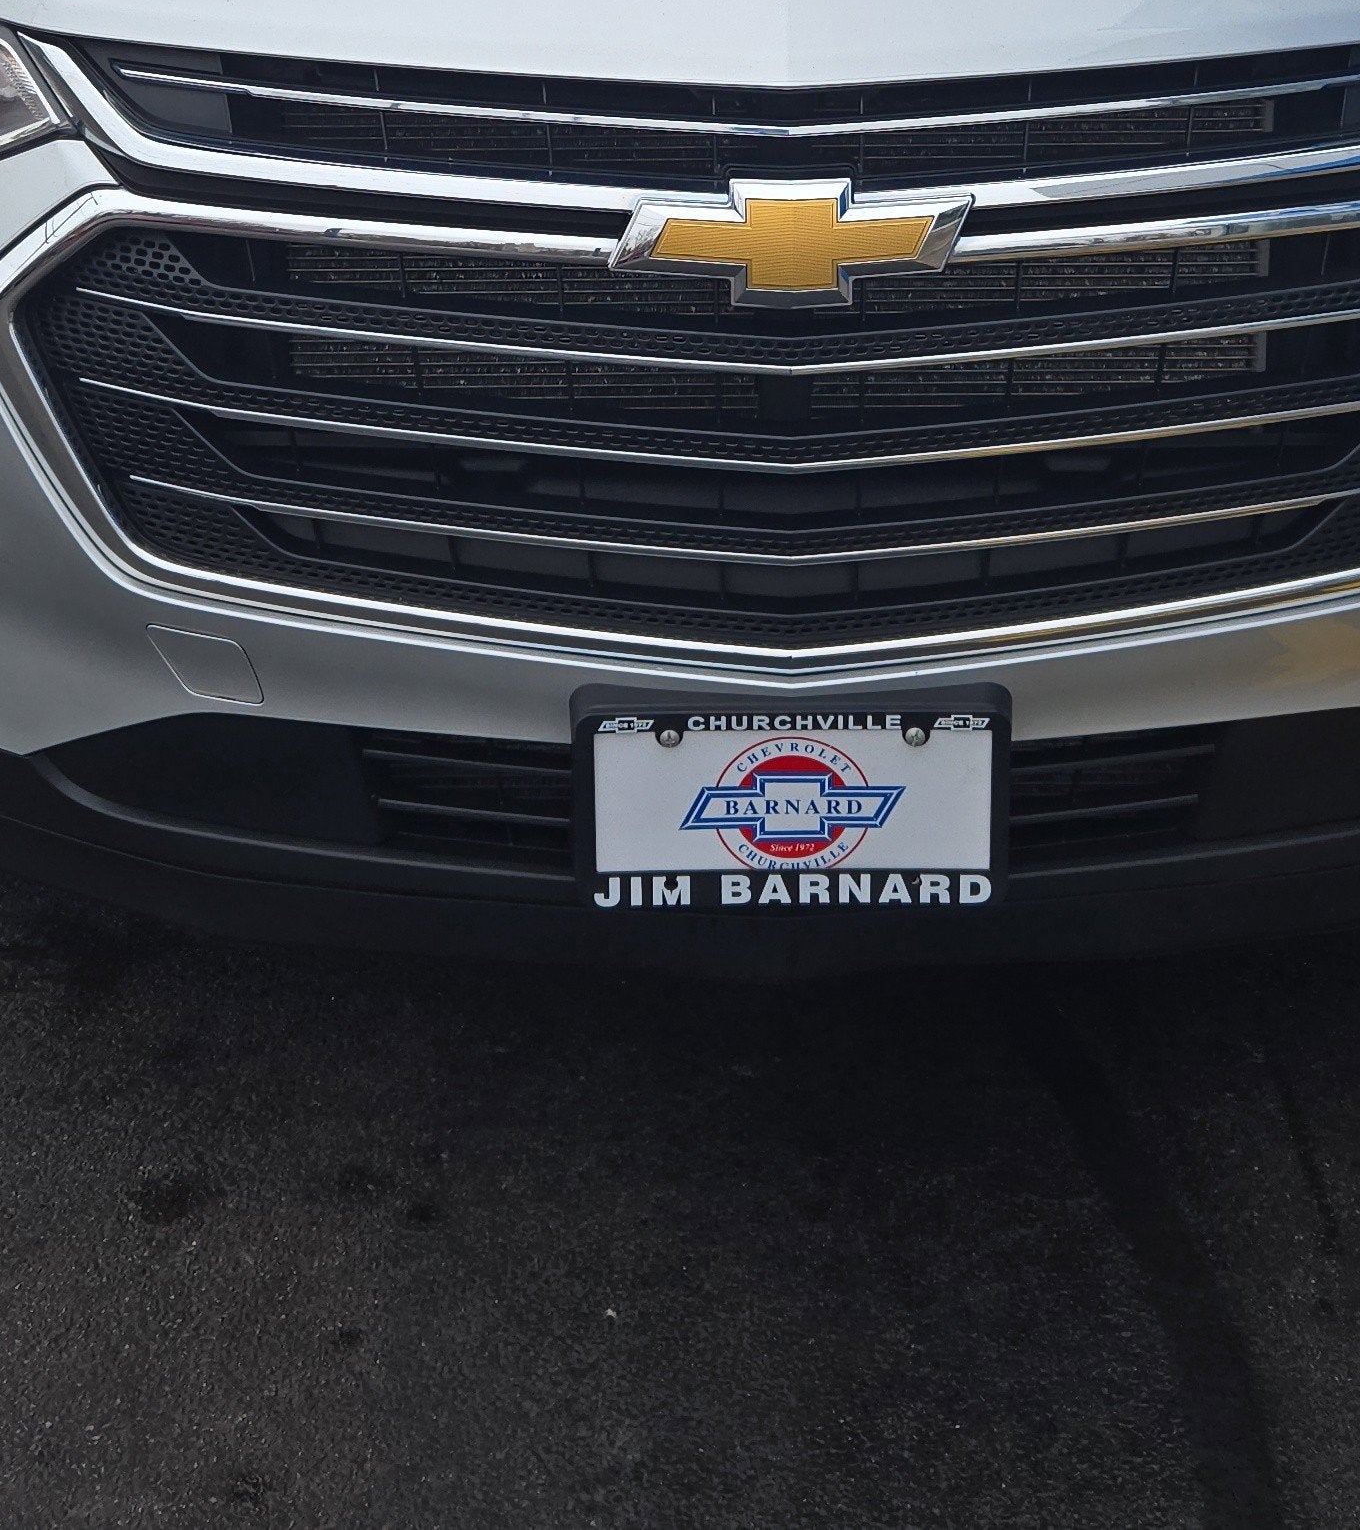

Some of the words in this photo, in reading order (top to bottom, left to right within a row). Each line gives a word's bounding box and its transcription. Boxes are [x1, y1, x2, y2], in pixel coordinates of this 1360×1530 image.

[687, 714, 903, 732] CHURCHVILLE
[736, 742, 853, 773] CHEVROLET
[724, 798, 863, 816] BARNARD
[738, 841, 850, 869] CHURCHVILLE
[769, 843, 793, 852] Since
[794, 843, 816, 852] 1972
[593, 875, 691, 908] JIM
[721, 873, 993, 907] BARNARD
